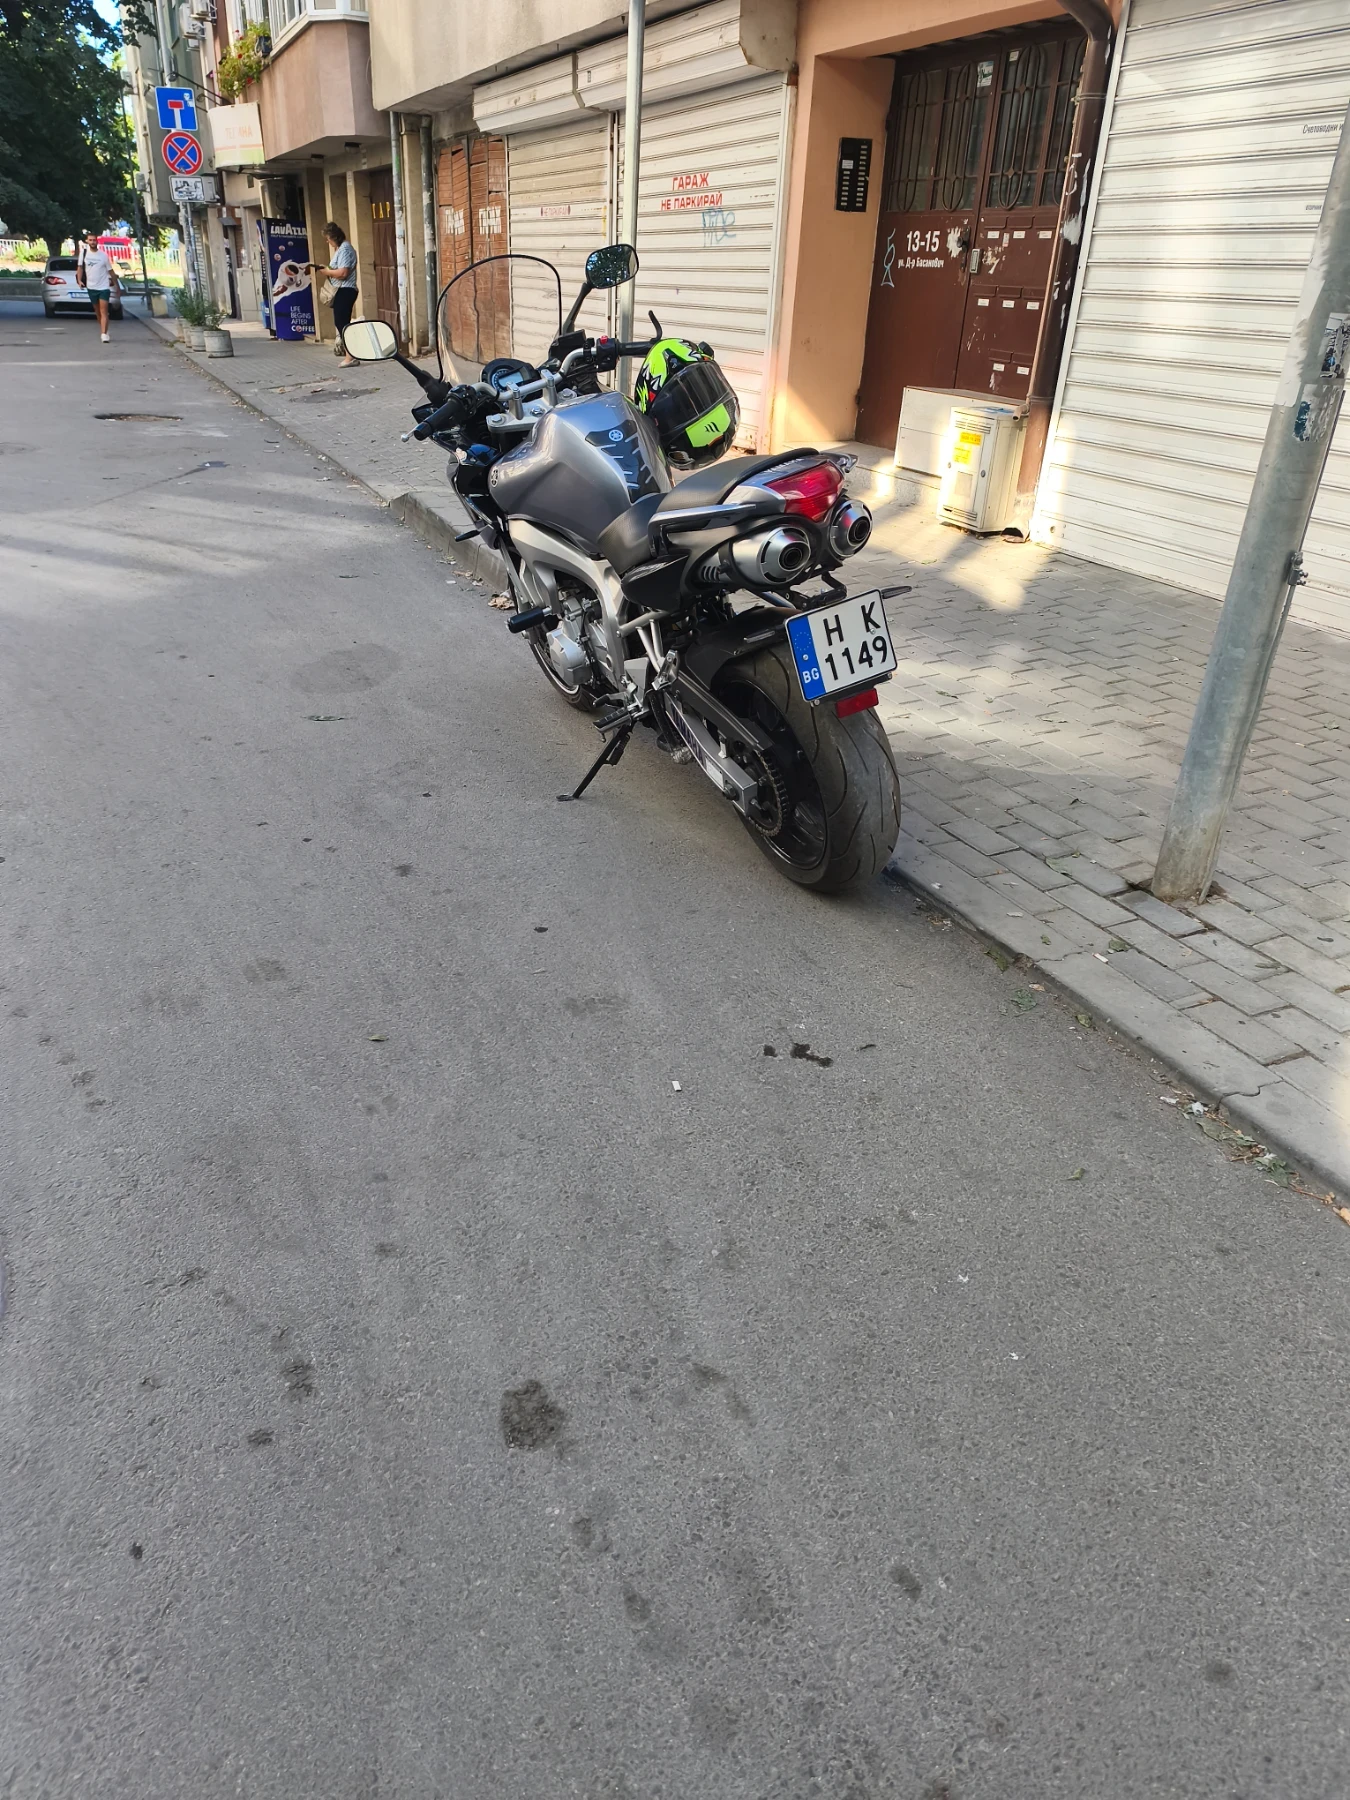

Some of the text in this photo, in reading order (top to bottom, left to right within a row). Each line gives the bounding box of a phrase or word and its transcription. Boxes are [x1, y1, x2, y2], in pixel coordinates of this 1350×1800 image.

[672, 172, 709, 191] ГАРАЖ
[661, 191, 722, 211] НЕ ПАРКИРАЙ
[907, 230, 941, 252] 13-15
[823, 601, 881, 646] H K
[825, 635, 888, 681] 1149
[802, 667, 820, 684] BG
